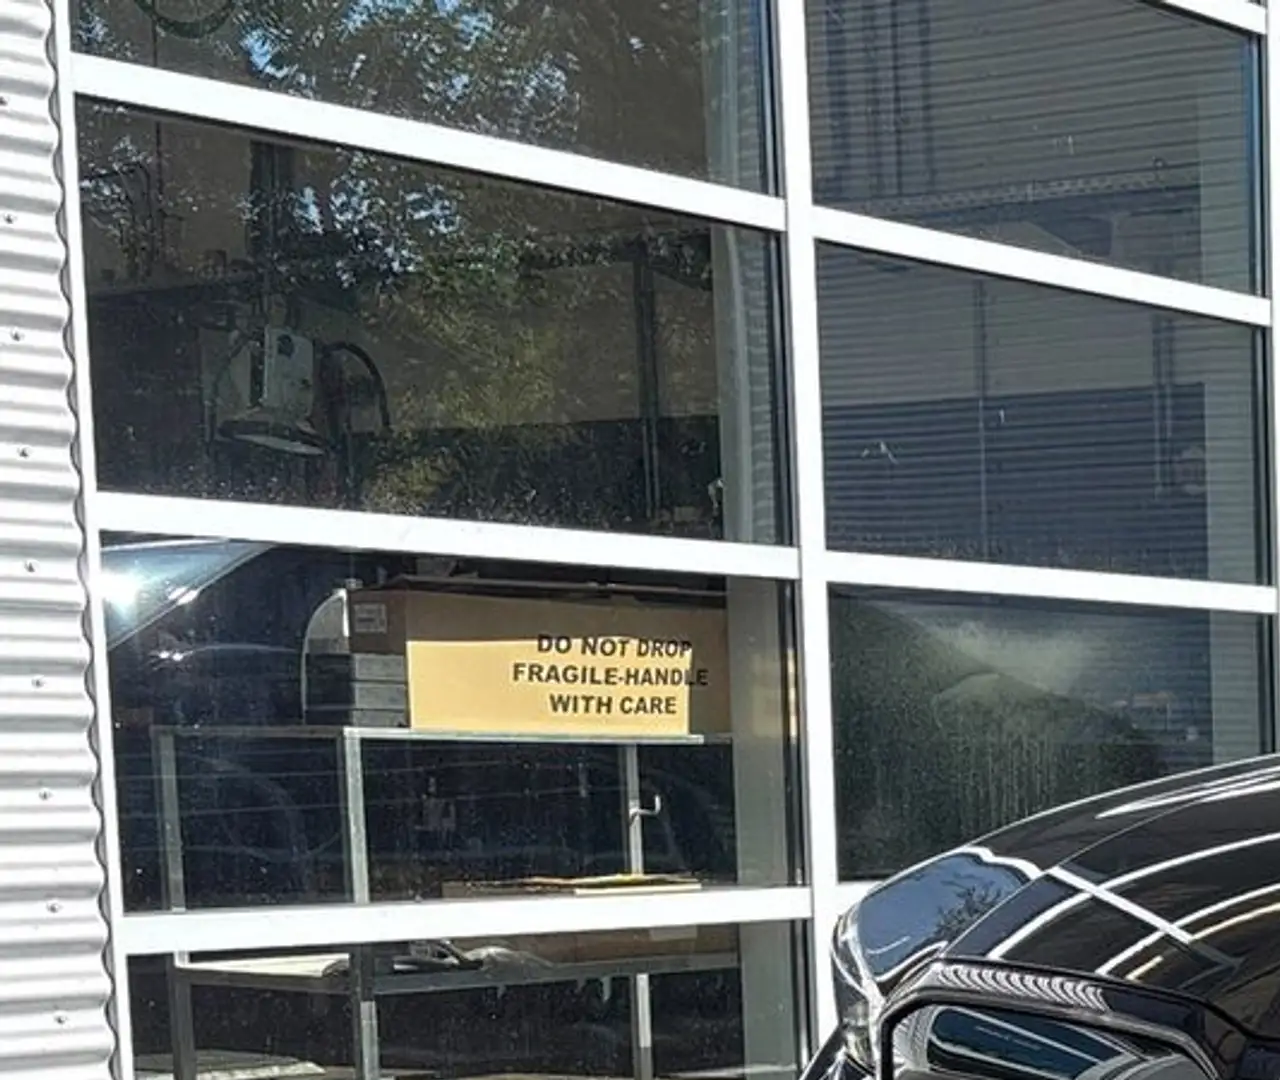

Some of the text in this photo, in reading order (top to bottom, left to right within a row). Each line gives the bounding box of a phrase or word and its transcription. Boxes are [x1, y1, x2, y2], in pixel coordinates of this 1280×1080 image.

[537, 634, 693, 658] DO NOT DROP
[512, 662, 709, 686] FRAGILE-HANDLE
[549, 693, 677, 714] WITH CARE
